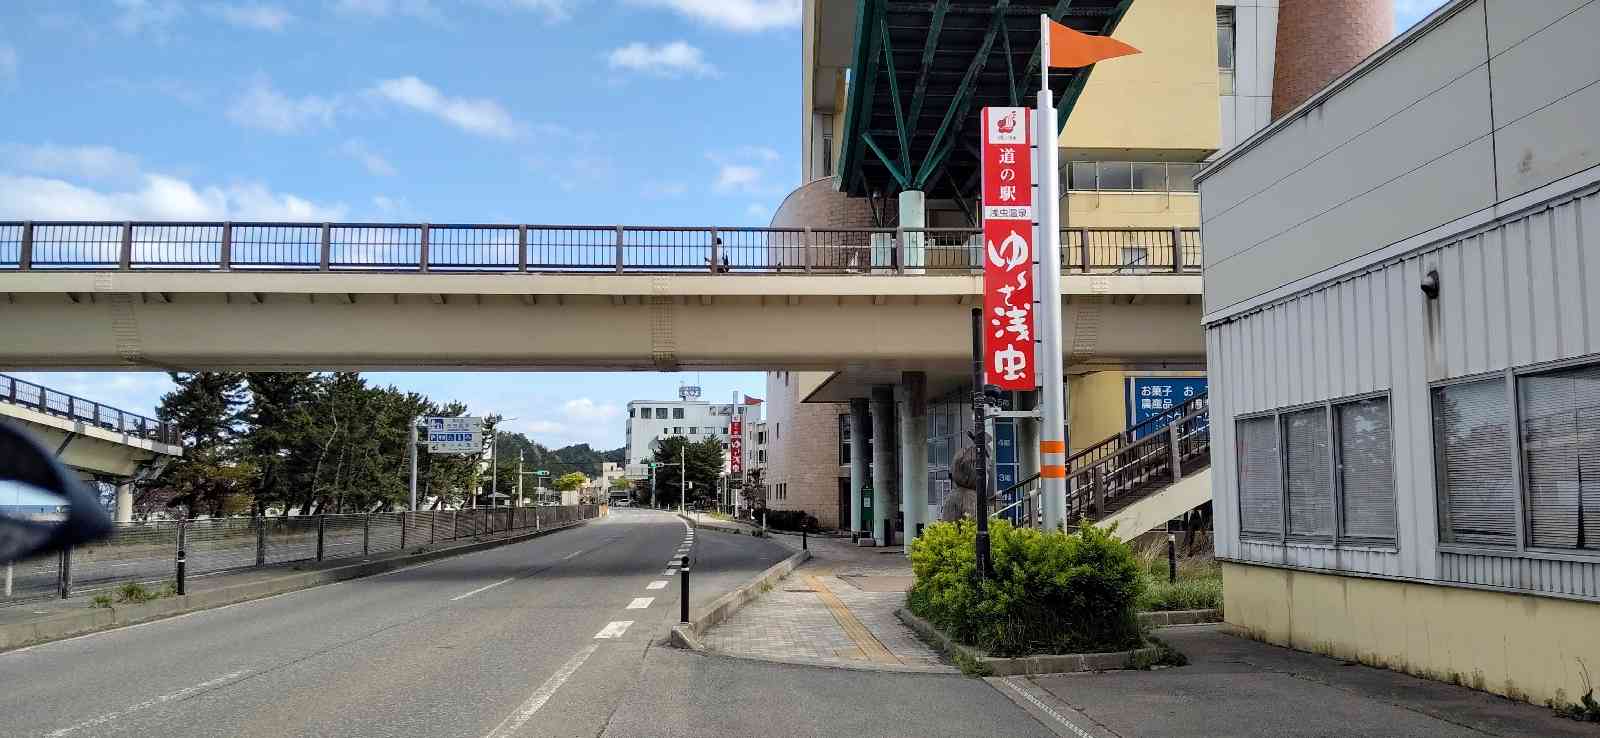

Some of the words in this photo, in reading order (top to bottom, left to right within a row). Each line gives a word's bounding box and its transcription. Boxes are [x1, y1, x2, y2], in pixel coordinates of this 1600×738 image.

[999, 147, 1016, 202] 道の駅
[1141, 385, 1172, 397] お菓子
[1141, 398, 1173, 410] 農産品
